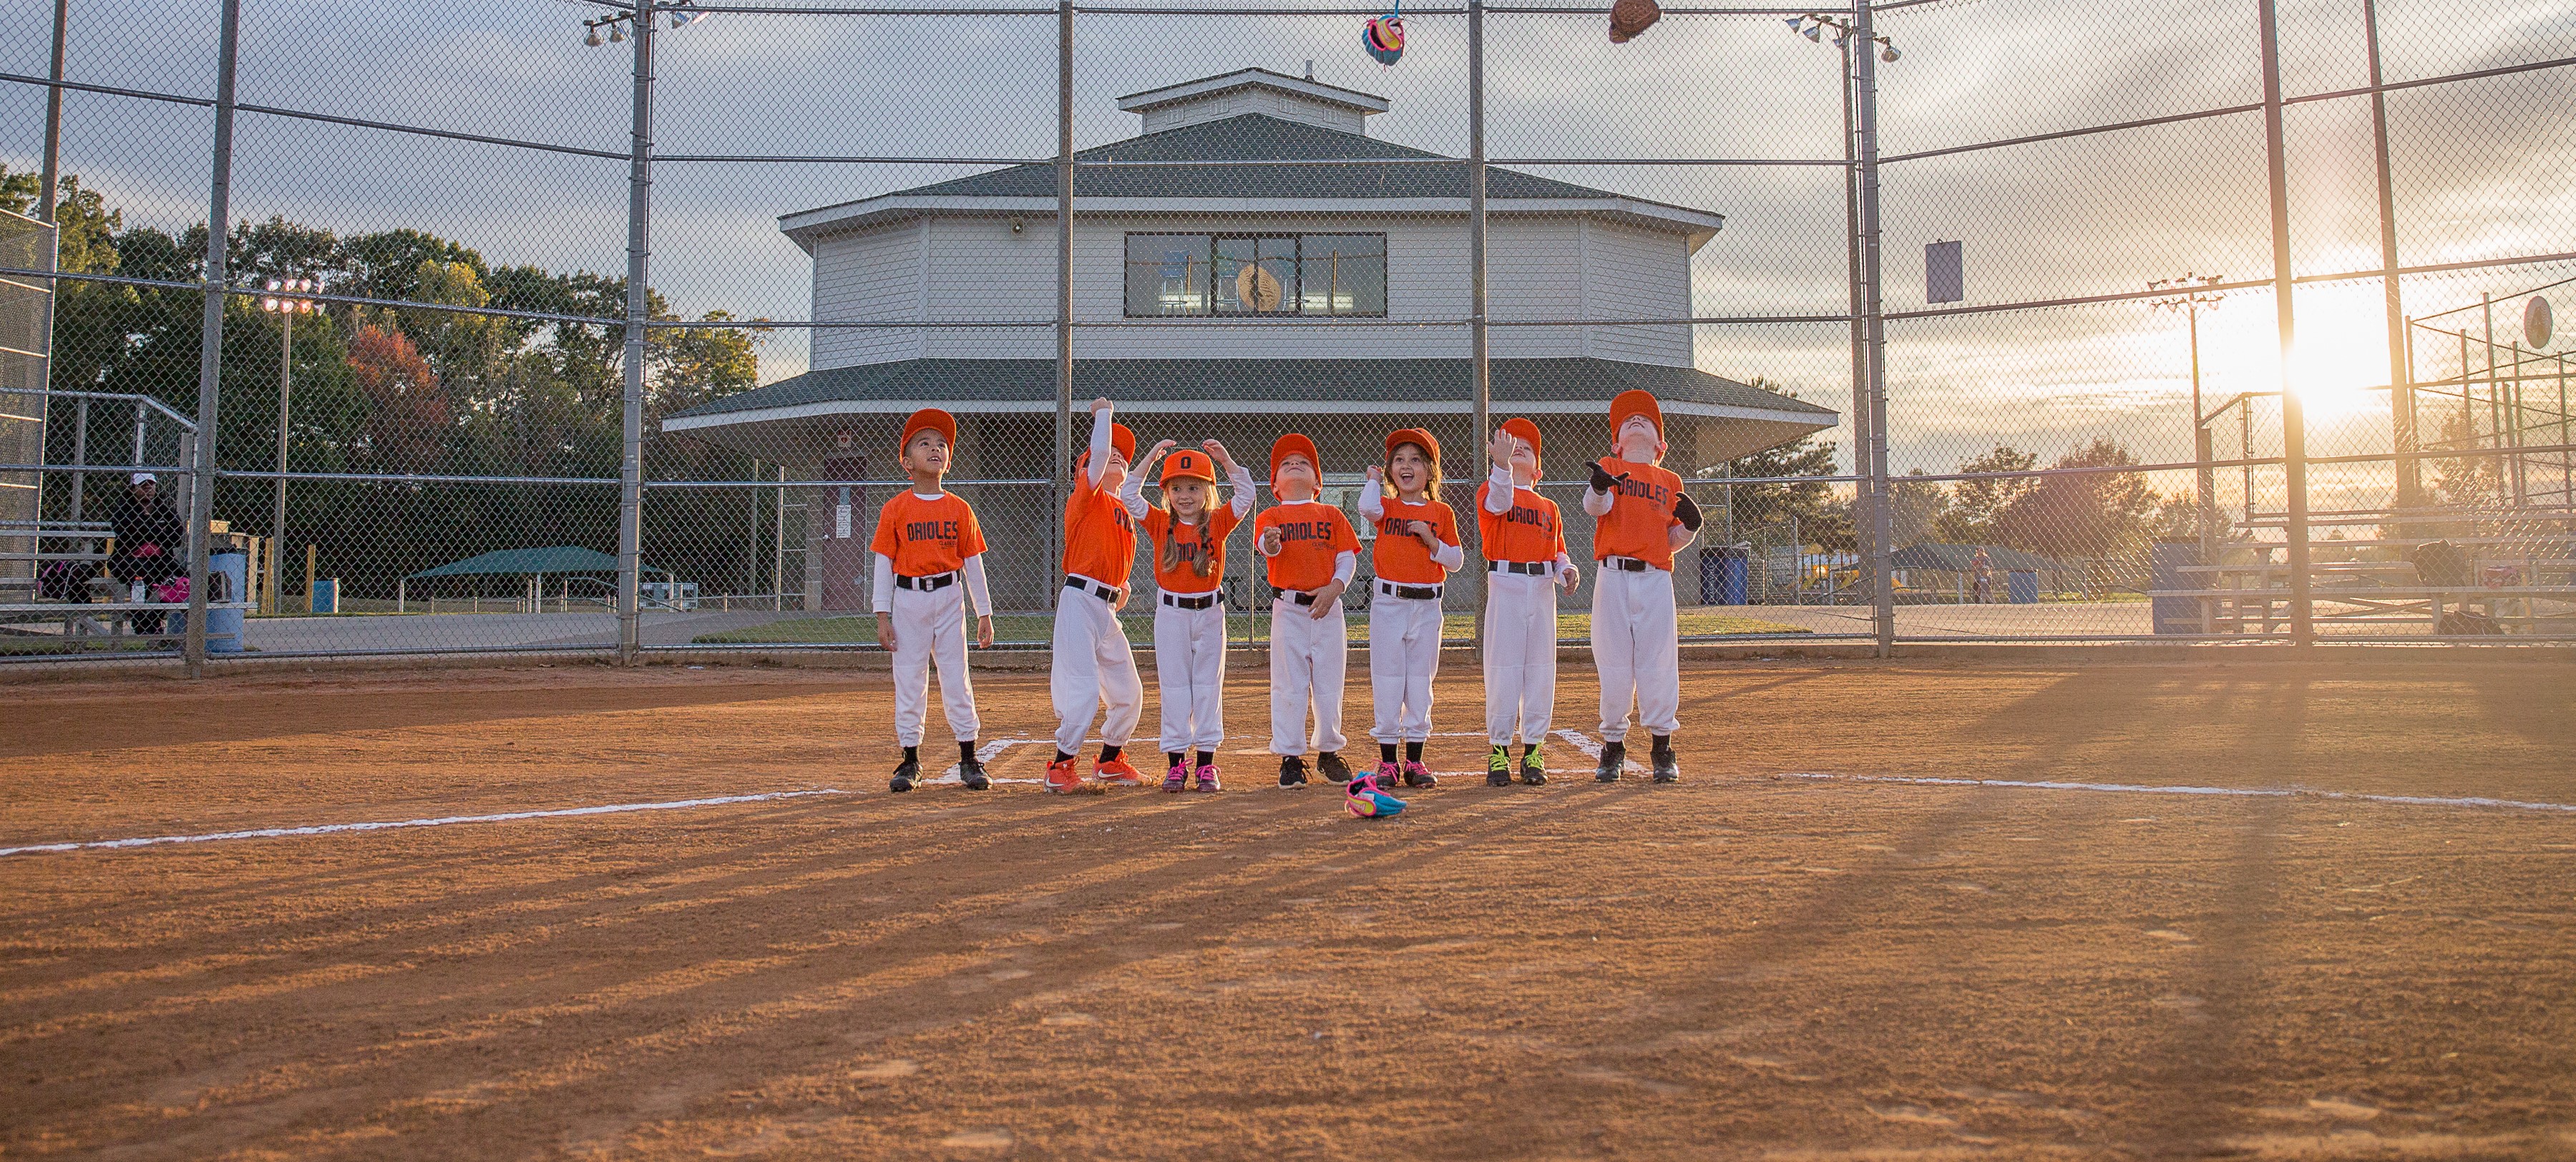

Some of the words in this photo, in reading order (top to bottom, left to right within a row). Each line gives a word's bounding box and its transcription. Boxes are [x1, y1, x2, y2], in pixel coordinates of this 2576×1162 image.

[1181, 456, 1191, 469] O
[1618, 479, 1669, 505] ORIOLES
[1385, 517, 1438, 538] ORIOS
[1507, 505, 1553, 532] ORIOLES
[907, 521, 957, 542] ORIOLES
[1279, 522, 1332, 542] ORIOLES
